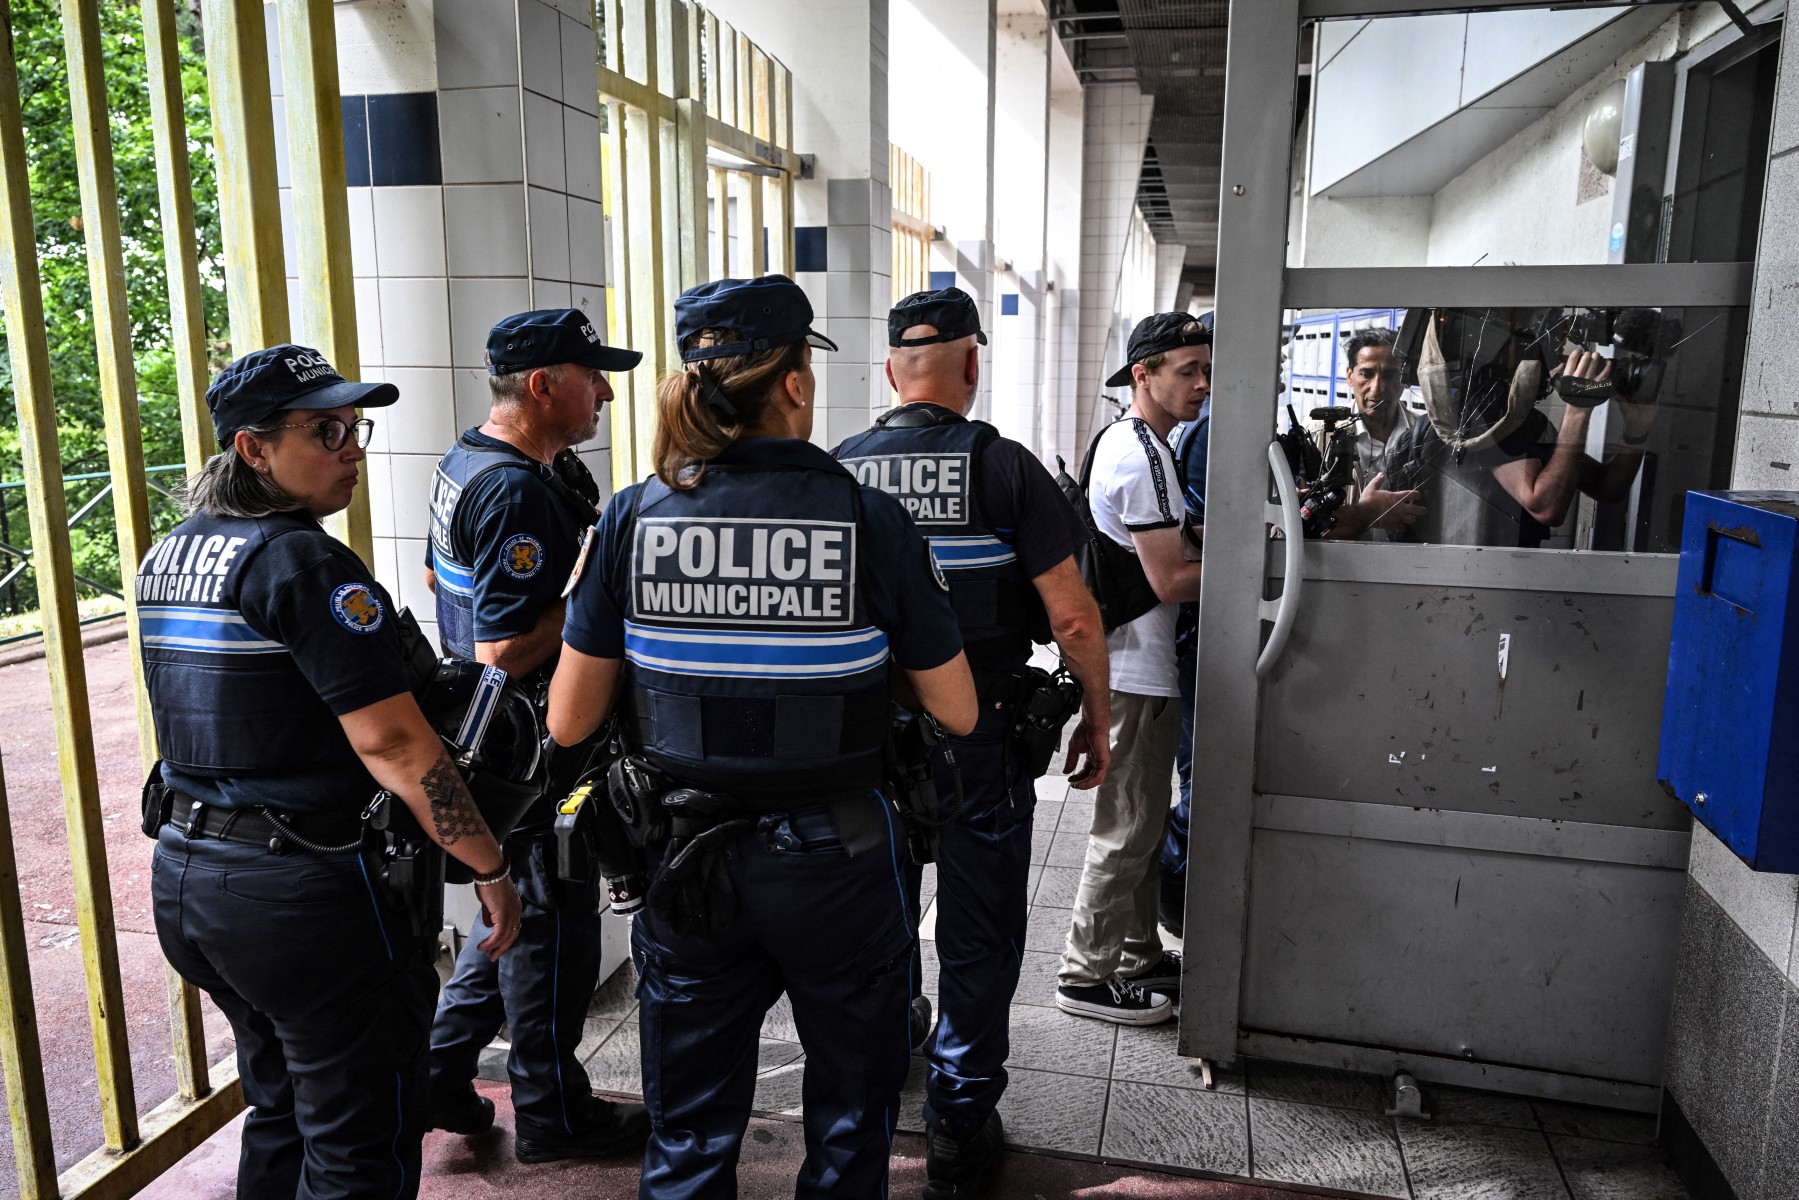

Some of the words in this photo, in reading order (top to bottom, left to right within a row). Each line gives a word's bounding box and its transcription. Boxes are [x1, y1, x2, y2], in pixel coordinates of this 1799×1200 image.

[137, 534, 248, 576] POLICE
[641, 525, 844, 582] POLICE
[136, 574, 226, 603] MUNICIPALE
[641, 581, 843, 618] MUNICIPALE
